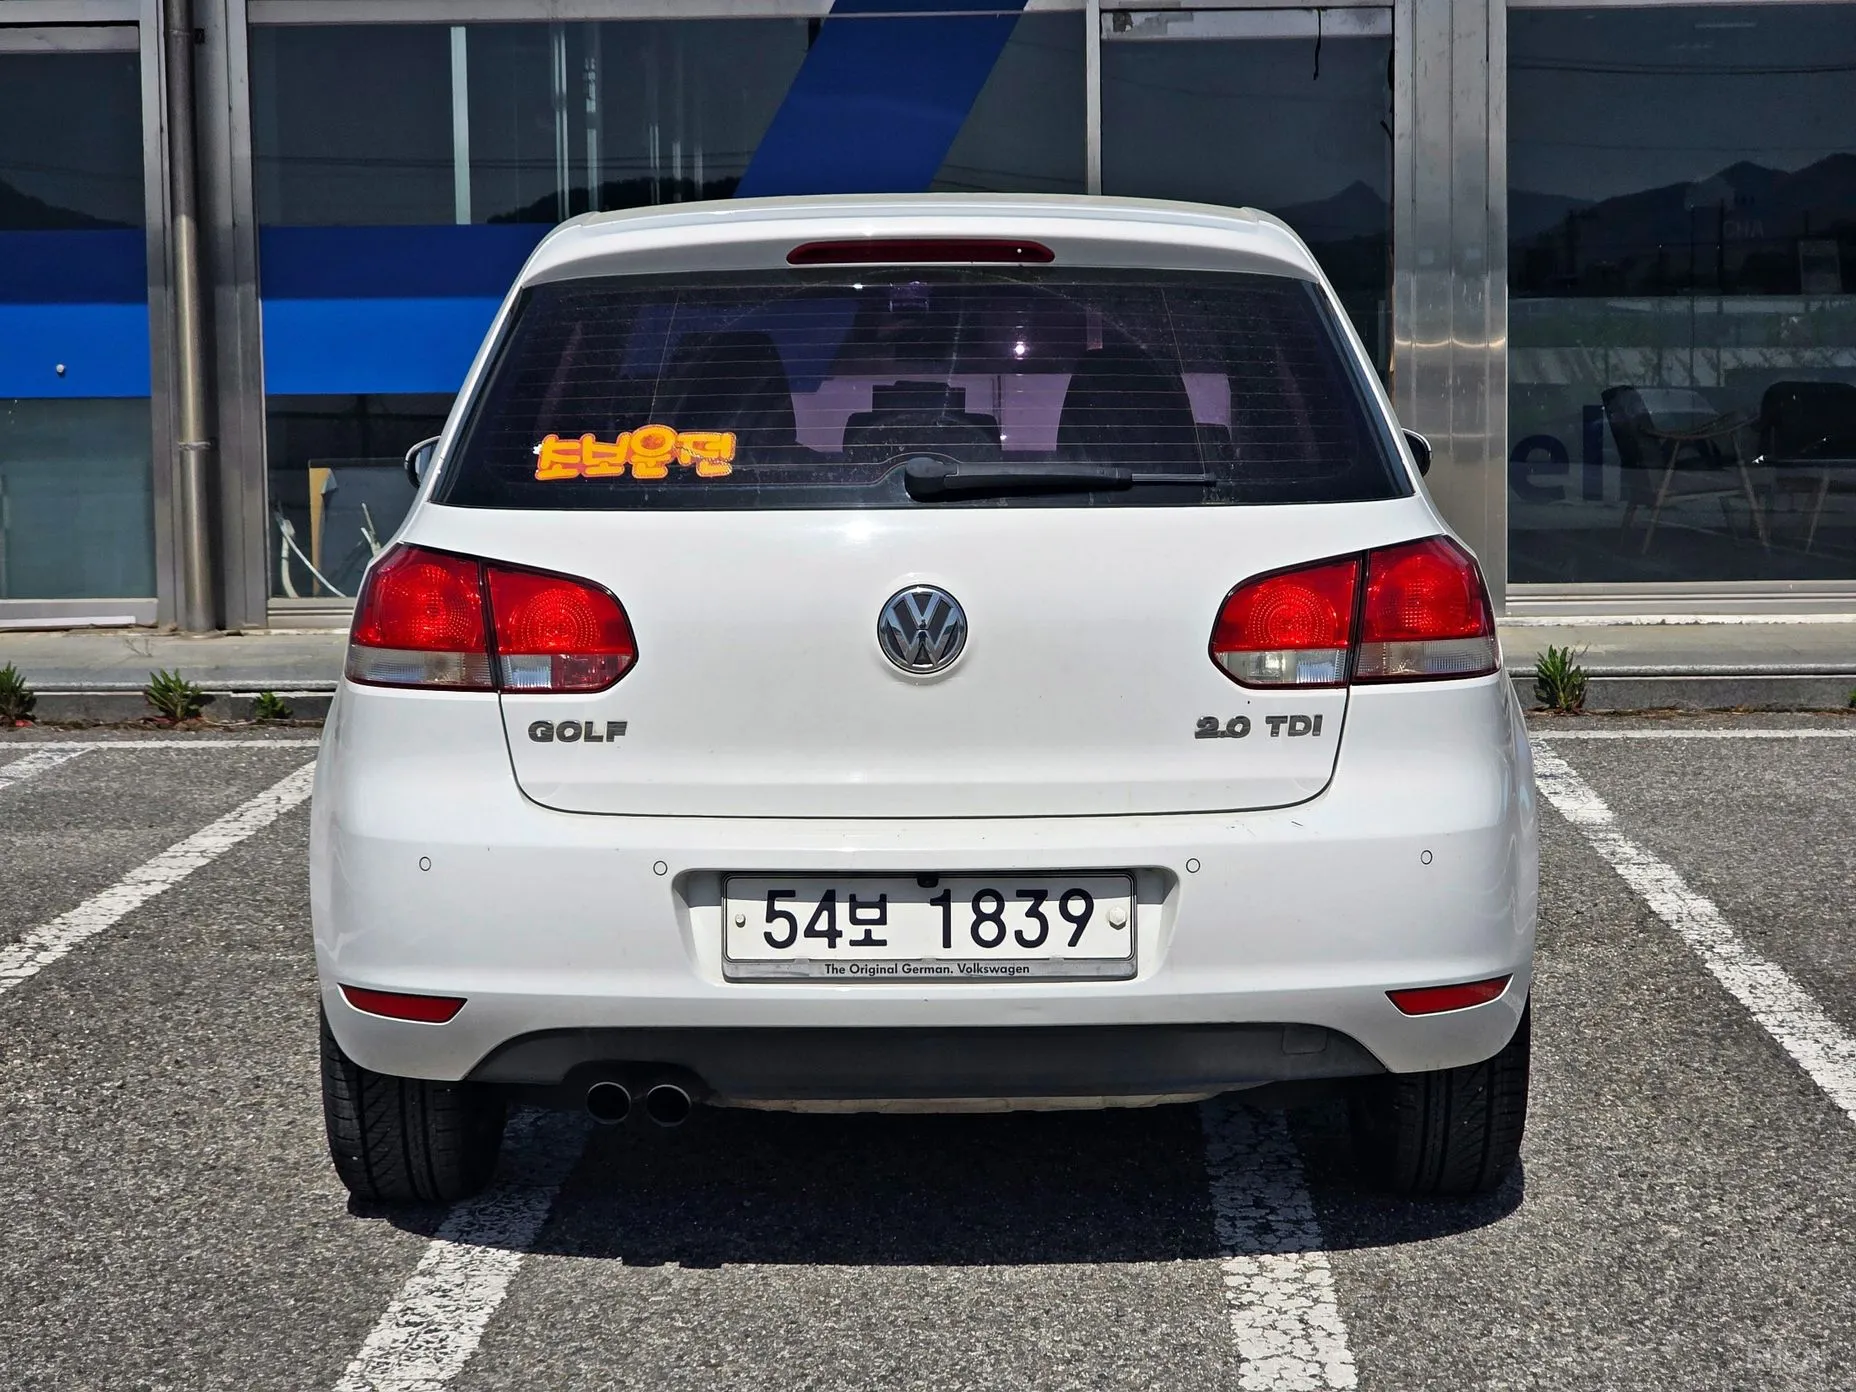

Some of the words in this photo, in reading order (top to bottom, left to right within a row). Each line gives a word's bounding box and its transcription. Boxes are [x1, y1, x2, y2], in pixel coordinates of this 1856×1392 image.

[528, 720, 628, 742] GOLF
[1194, 715, 1252, 739] 2.0
[1265, 714, 1323, 737] TDI
[763, 889, 888, 949] 54보
[929, 888, 1095, 949] 1839
[825, 963, 846, 974] The
[849, 963, 898, 976] Original
[901, 963, 954, 974] German.
[957, 962, 1030, 976] Volkswagen
